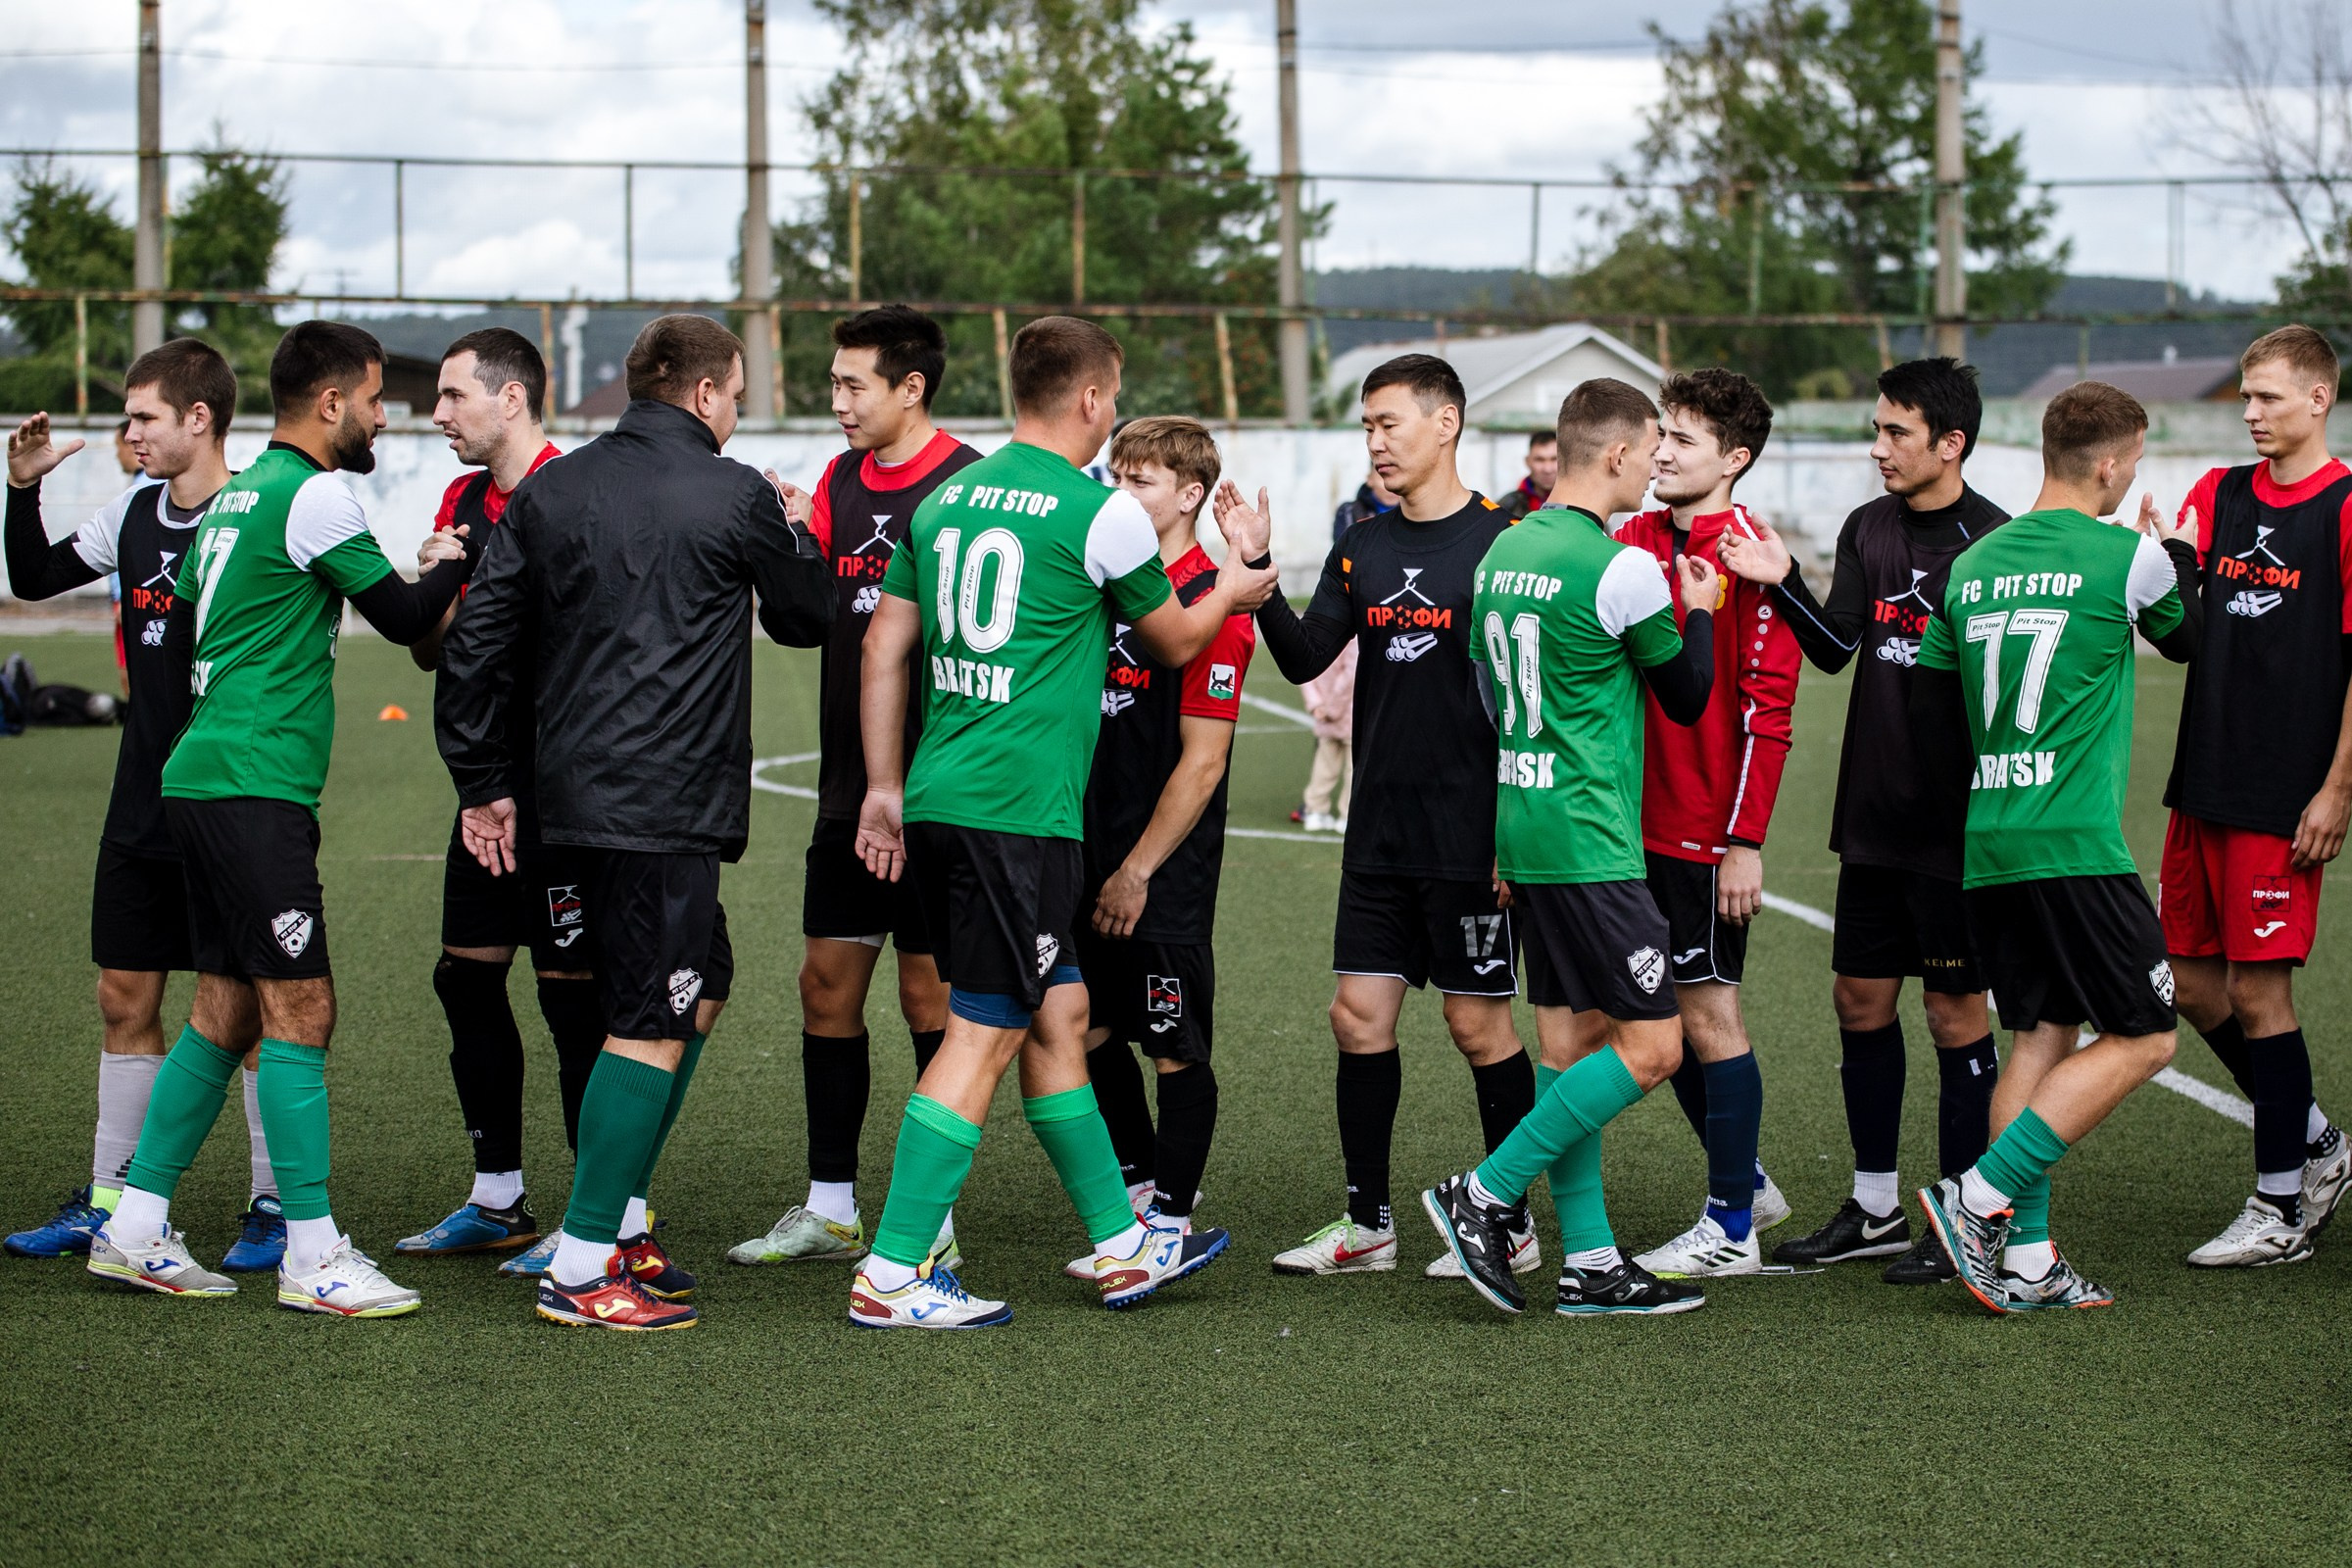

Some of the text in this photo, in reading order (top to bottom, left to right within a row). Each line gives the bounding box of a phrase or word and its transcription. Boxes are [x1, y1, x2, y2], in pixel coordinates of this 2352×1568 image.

[938, 484, 1059, 518] FC PIT STOP
[966, 564, 975, 592] Stop
[1475, 570, 1562, 602] C PIT STOP
[1961, 572, 2082, 605] FC PIT STOP
[2216, 556, 2302, 590] ПРОФИ
[933, 527, 1025, 654] 10
[1367, 604, 1452, 629] ПРОФИ
[2033, 617, 2057, 626] Stop
[1484, 611, 1544, 739] 91
[1965, 608, 2070, 734] 77
[2253, 890, 2289, 900] ПРОФИ
[1460, 914, 1502, 957] 17
[1924, 957, 1965, 967] KELME
